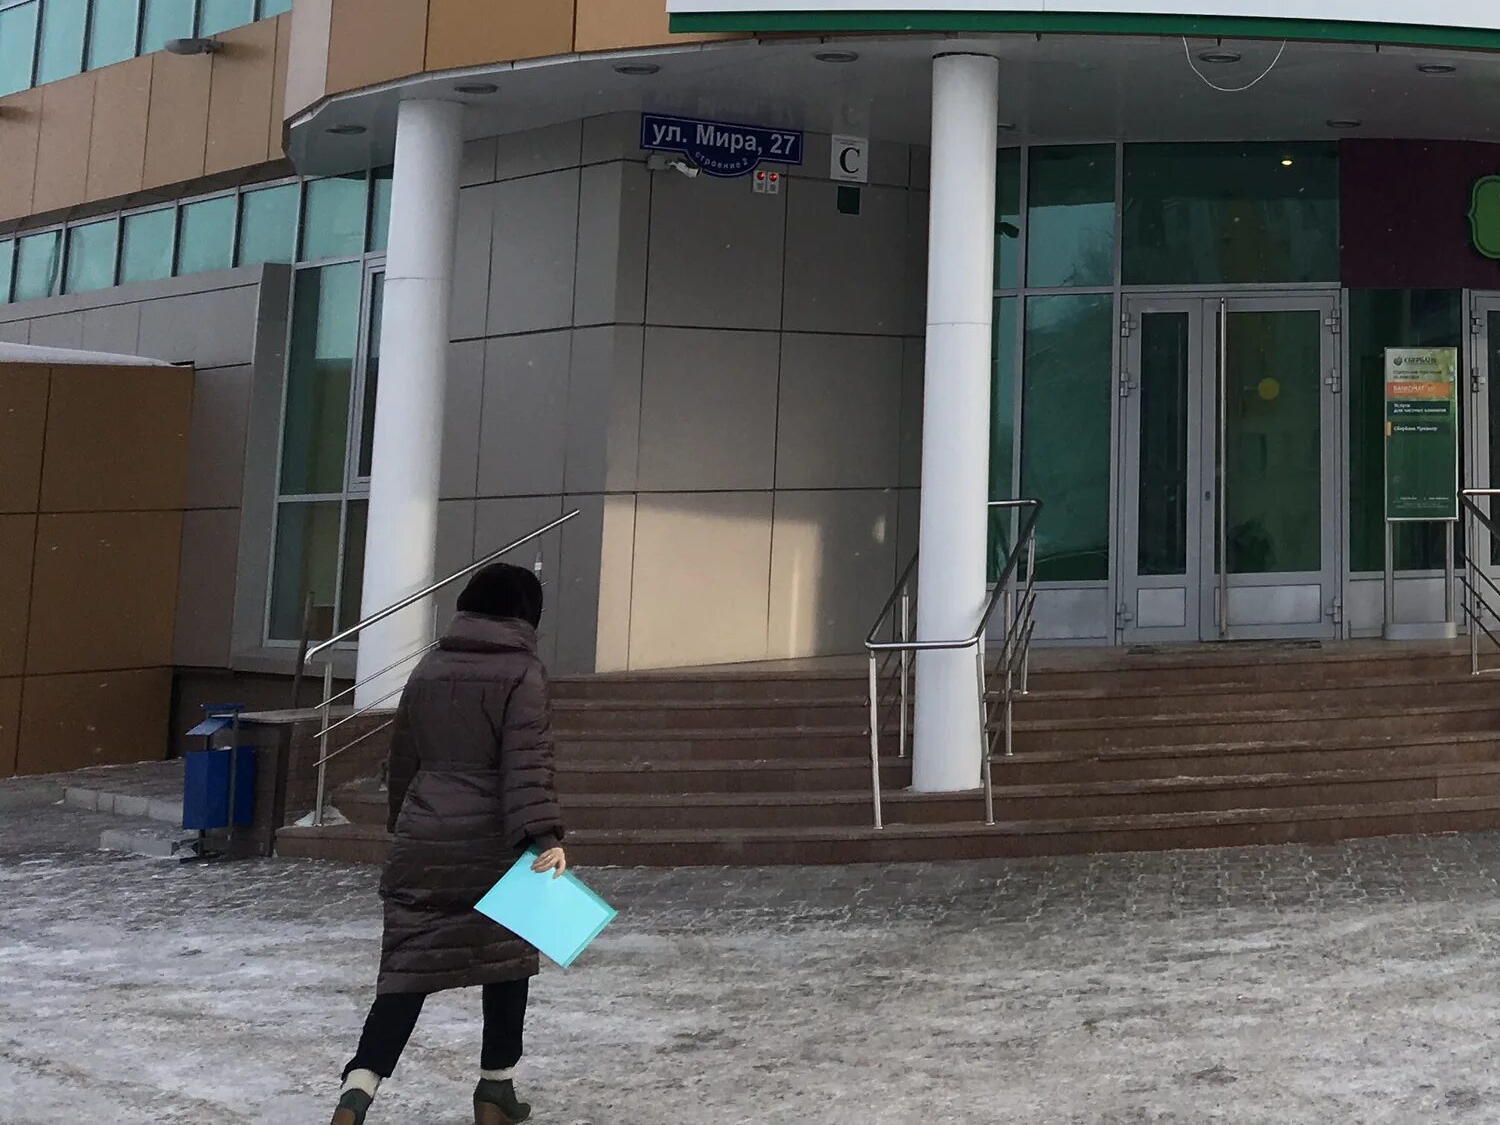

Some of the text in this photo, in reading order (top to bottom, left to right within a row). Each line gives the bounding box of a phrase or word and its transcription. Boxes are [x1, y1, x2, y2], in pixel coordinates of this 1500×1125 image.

[652, 124, 795, 155] ул. Мира, 27
[695, 151, 741, 169] строение
